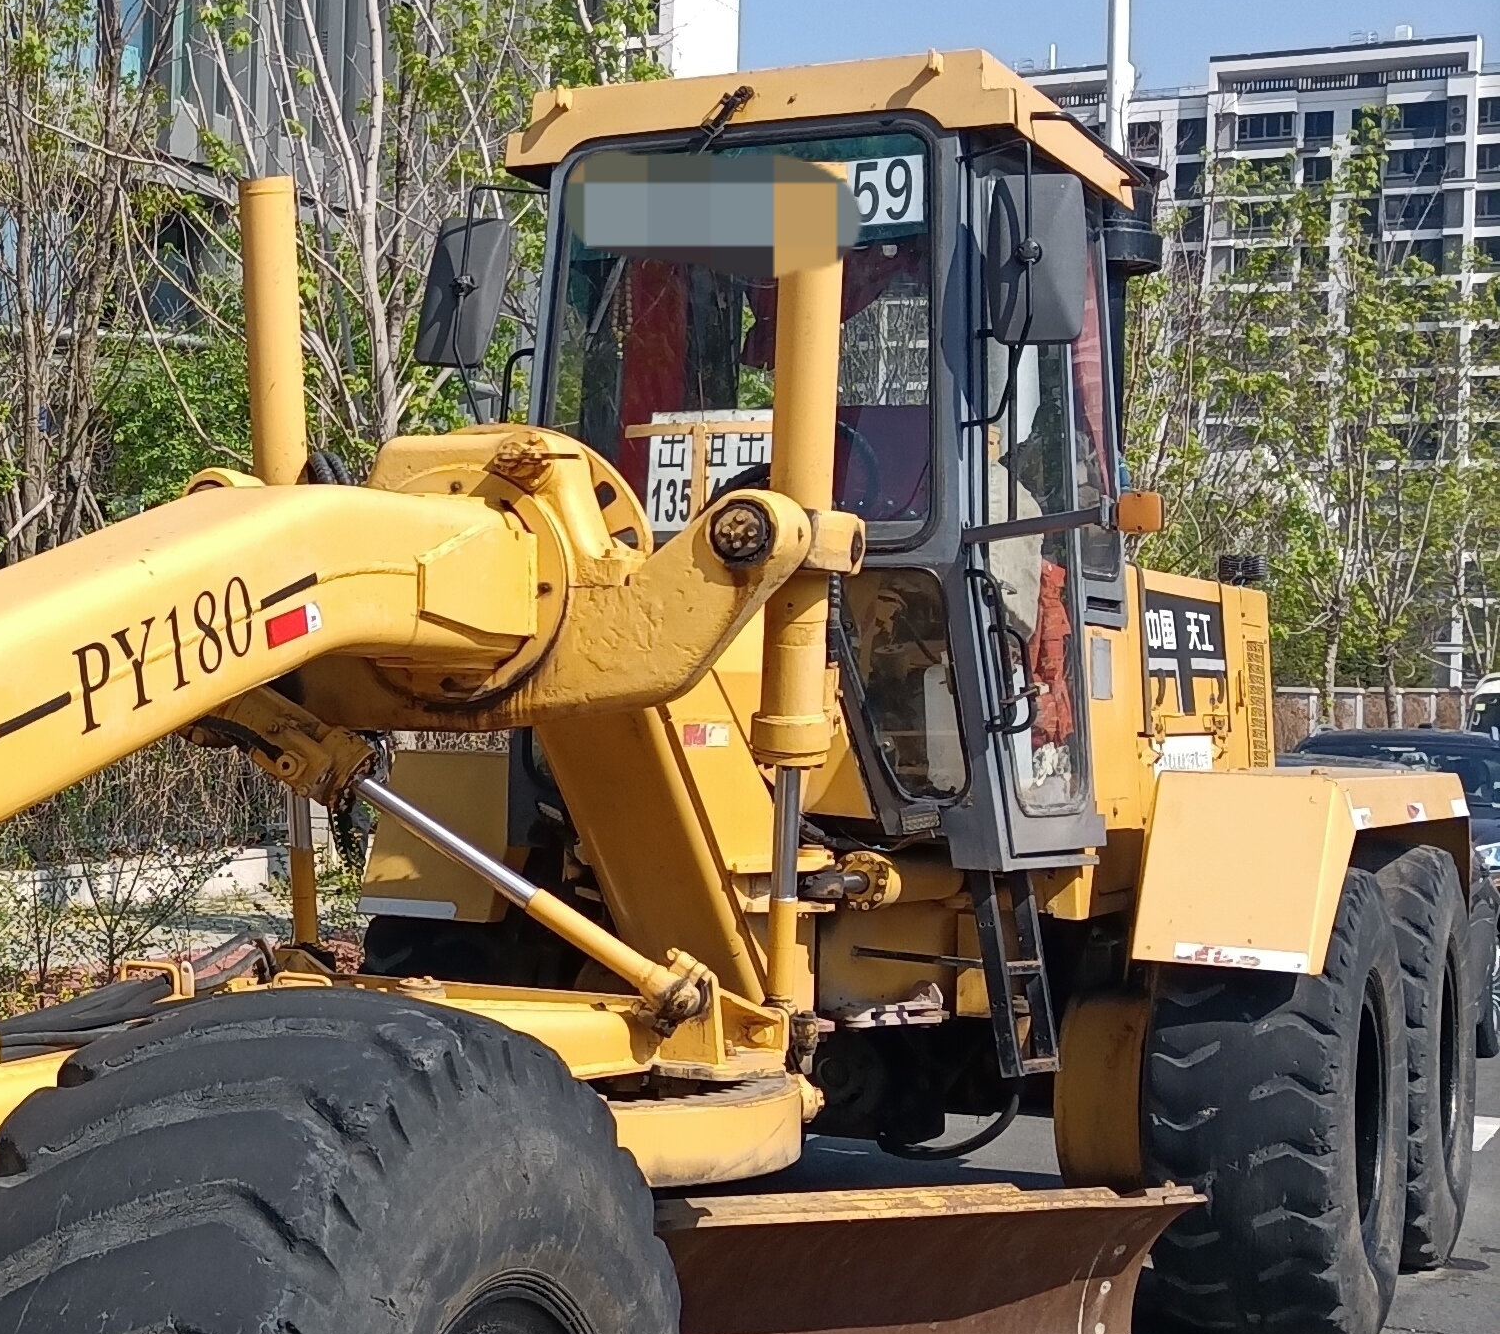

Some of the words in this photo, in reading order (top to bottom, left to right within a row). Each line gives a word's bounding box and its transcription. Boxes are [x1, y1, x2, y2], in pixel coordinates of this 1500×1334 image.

[71, 575, 253, 736] PY180
[1144, 608, 1177, 650] 中国
[1185, 611, 1215, 652] 天工
